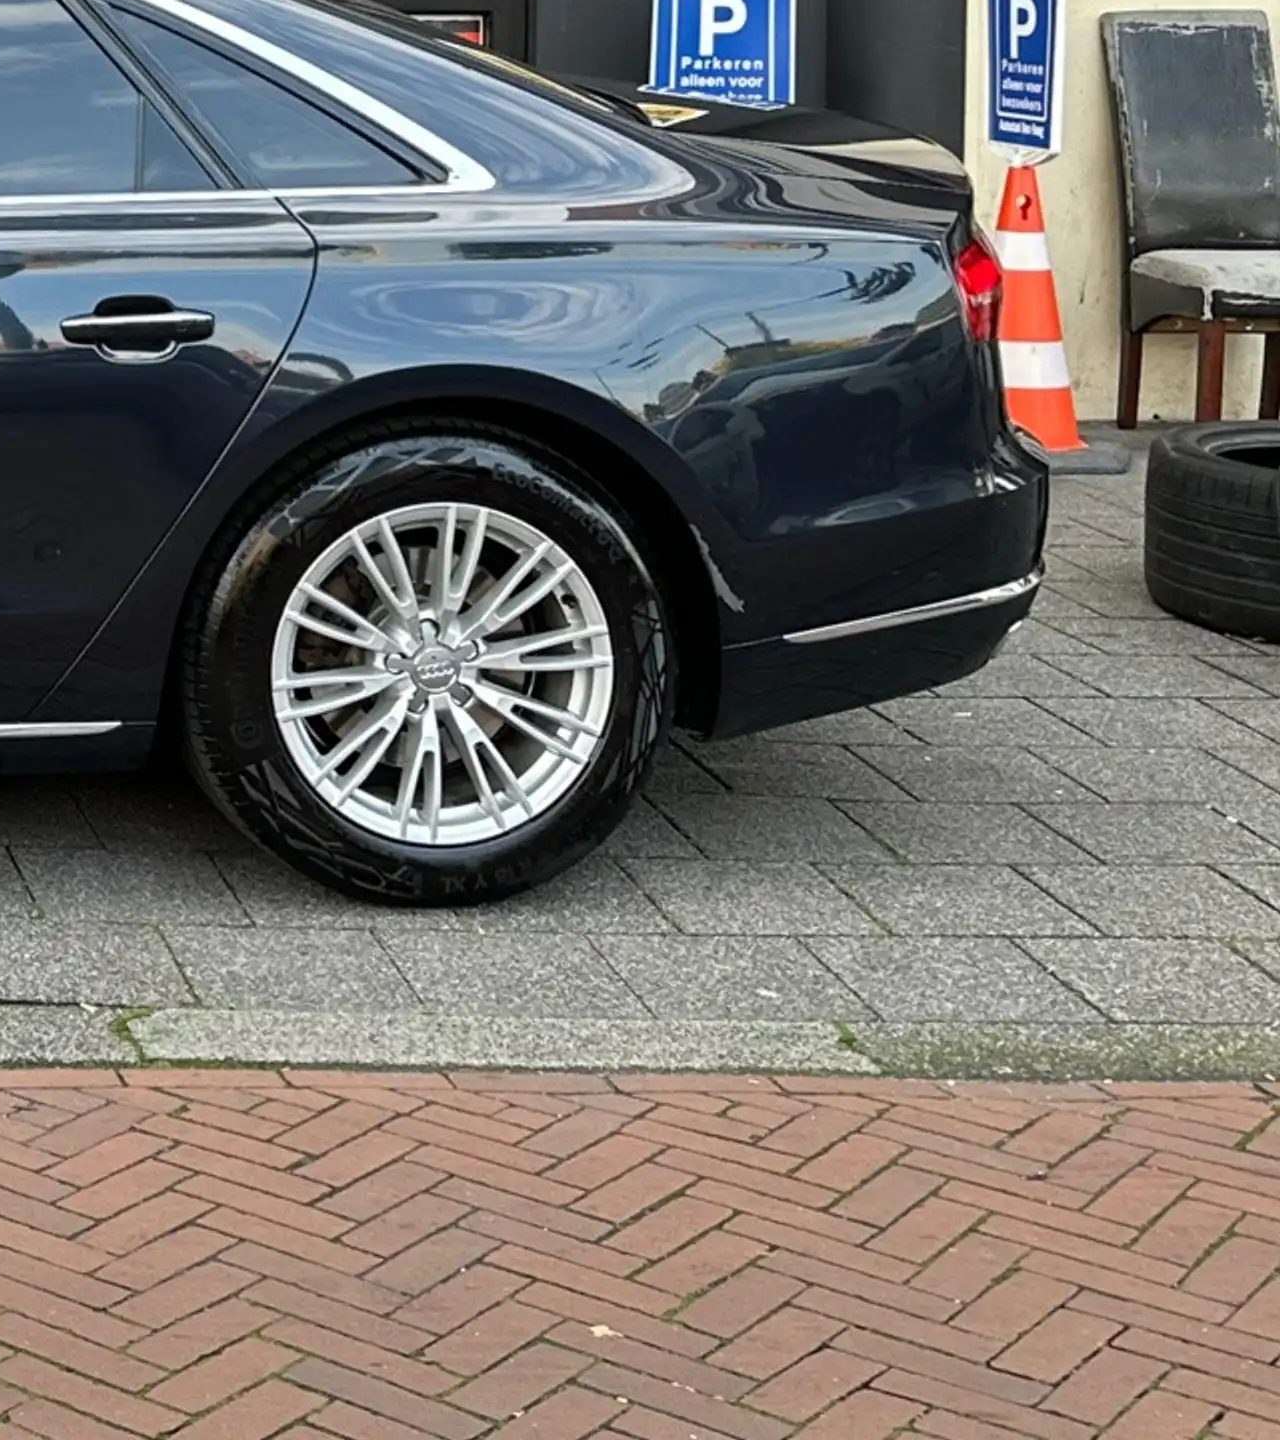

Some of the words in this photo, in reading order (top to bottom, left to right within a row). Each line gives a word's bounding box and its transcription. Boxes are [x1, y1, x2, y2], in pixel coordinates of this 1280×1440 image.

[680, 56, 764, 71] Parkeren
[1002, 58, 1043, 76] Parkeren
[680, 73, 726, 88] alleen
[728, 76, 764, 88] voor
